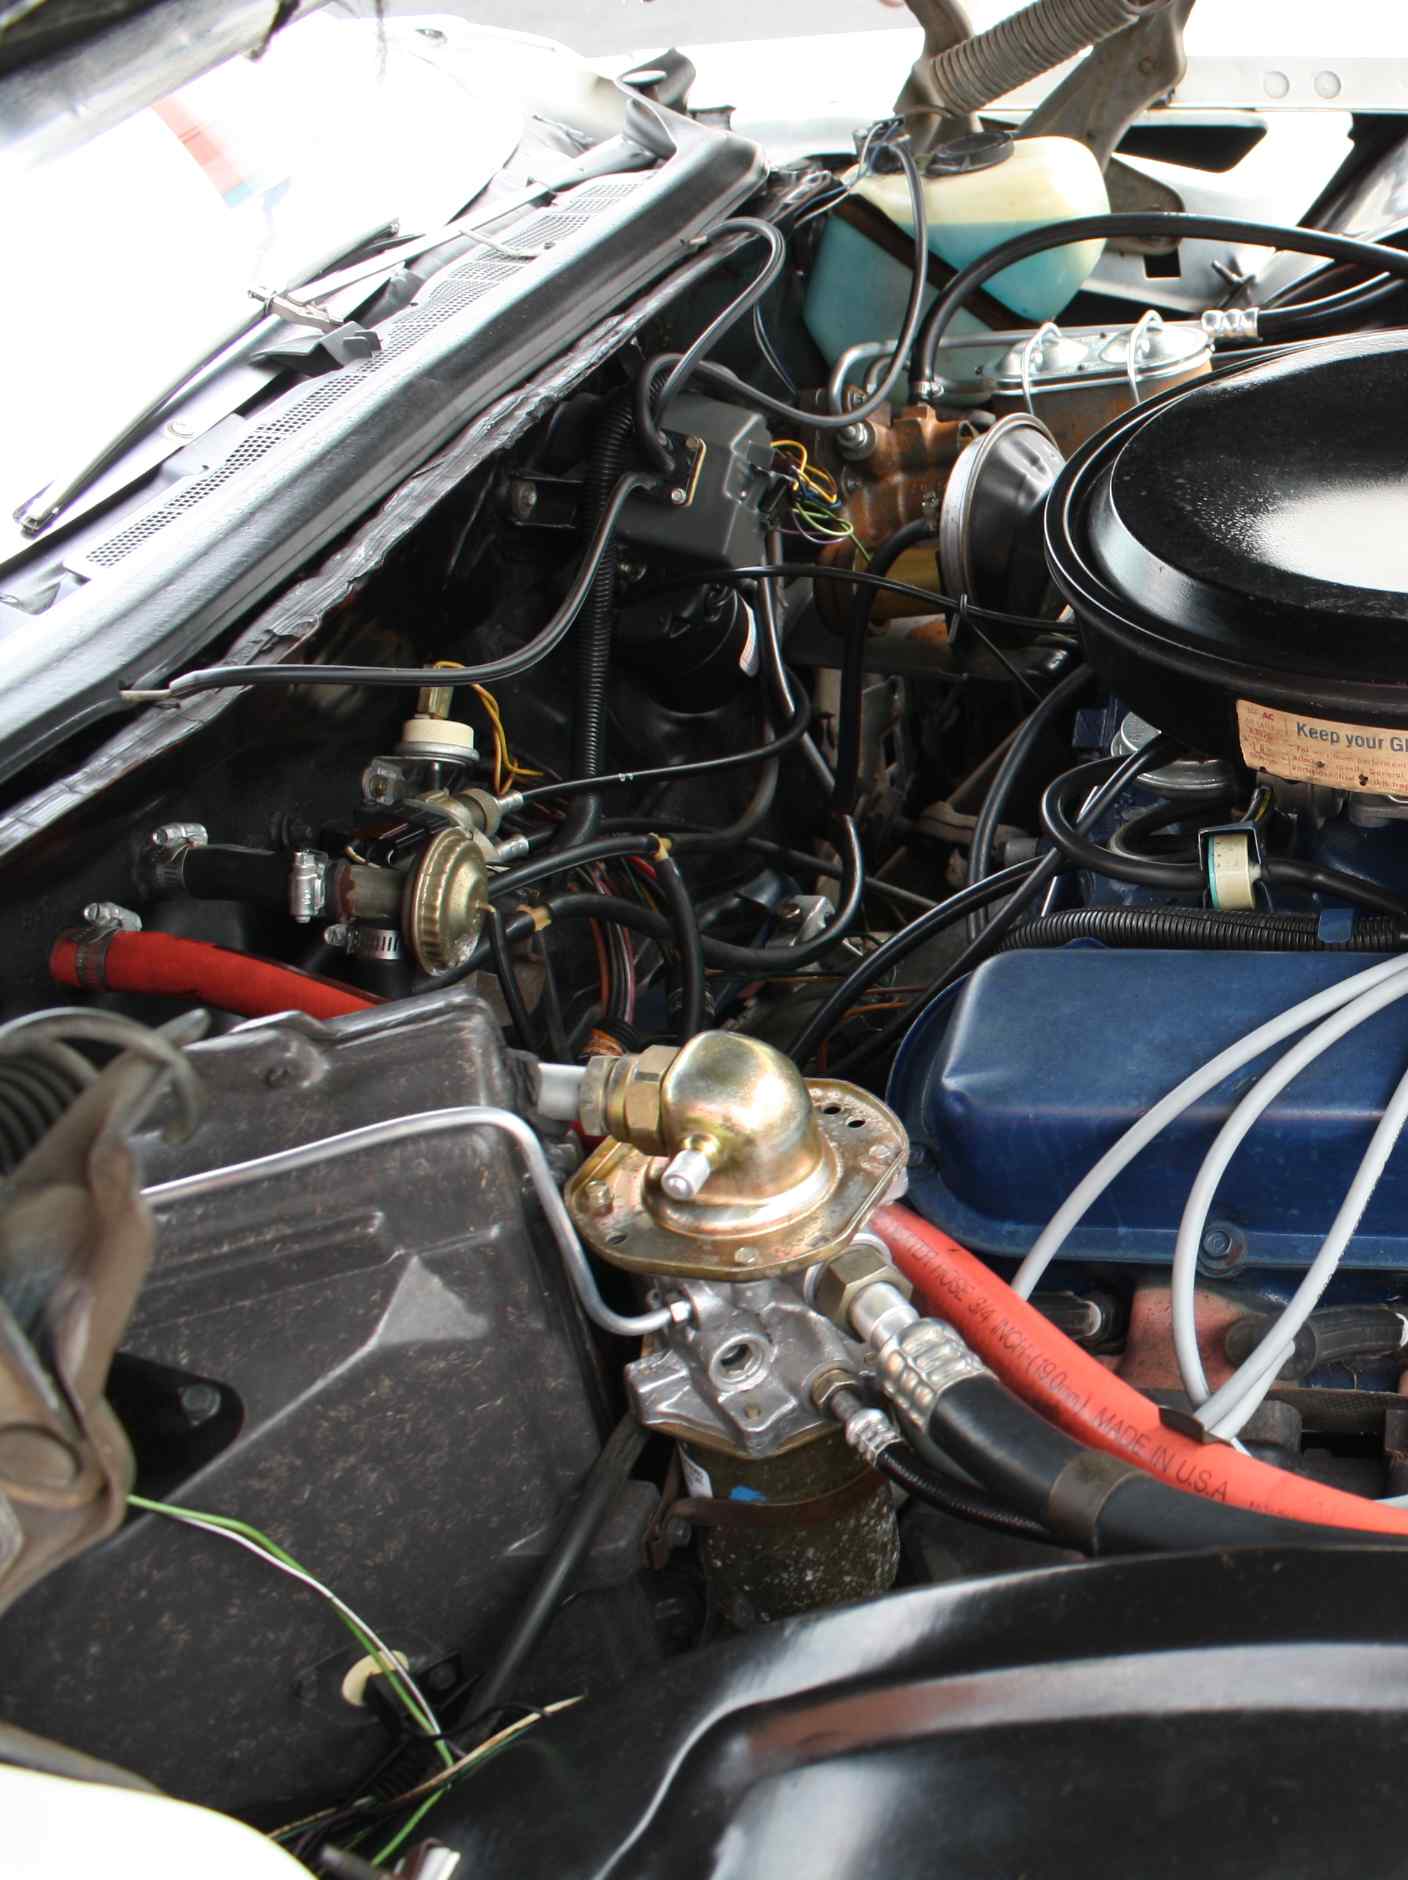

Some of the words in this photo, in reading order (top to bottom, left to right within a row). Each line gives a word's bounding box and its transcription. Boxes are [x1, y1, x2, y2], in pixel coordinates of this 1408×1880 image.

[1296, 722, 1340, 745] Keep
[1346, 733, 1384, 750] your
[1089, 1405, 1153, 1457] MADE
[1147, 1442, 1179, 1473] IN
